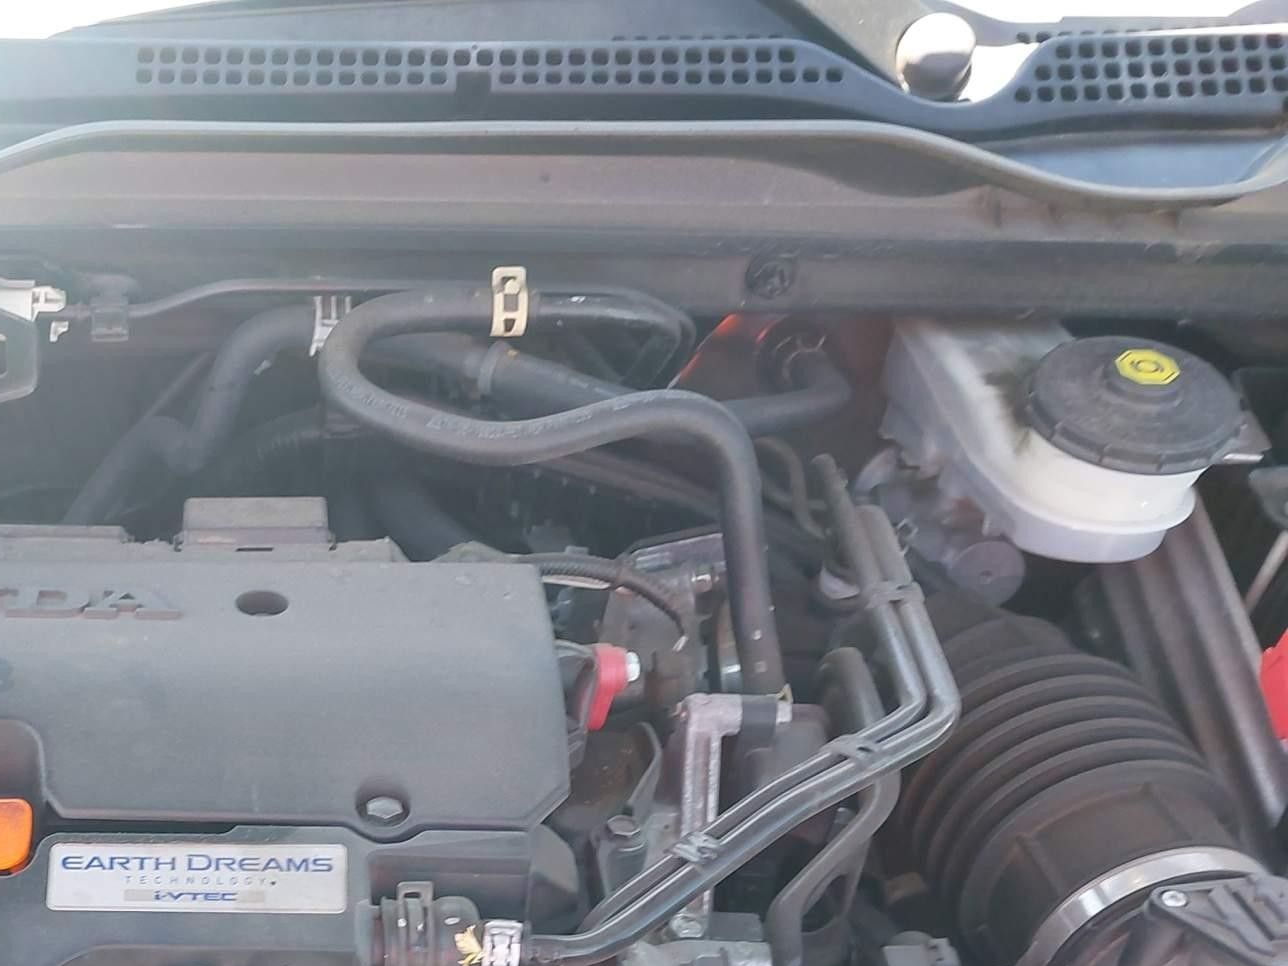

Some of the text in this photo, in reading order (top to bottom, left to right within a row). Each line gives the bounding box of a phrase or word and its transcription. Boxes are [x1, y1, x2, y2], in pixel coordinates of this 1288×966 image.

[61, 854, 334, 873] EARTH DREAMS
[153, 890, 239, 902] i-VTEC
